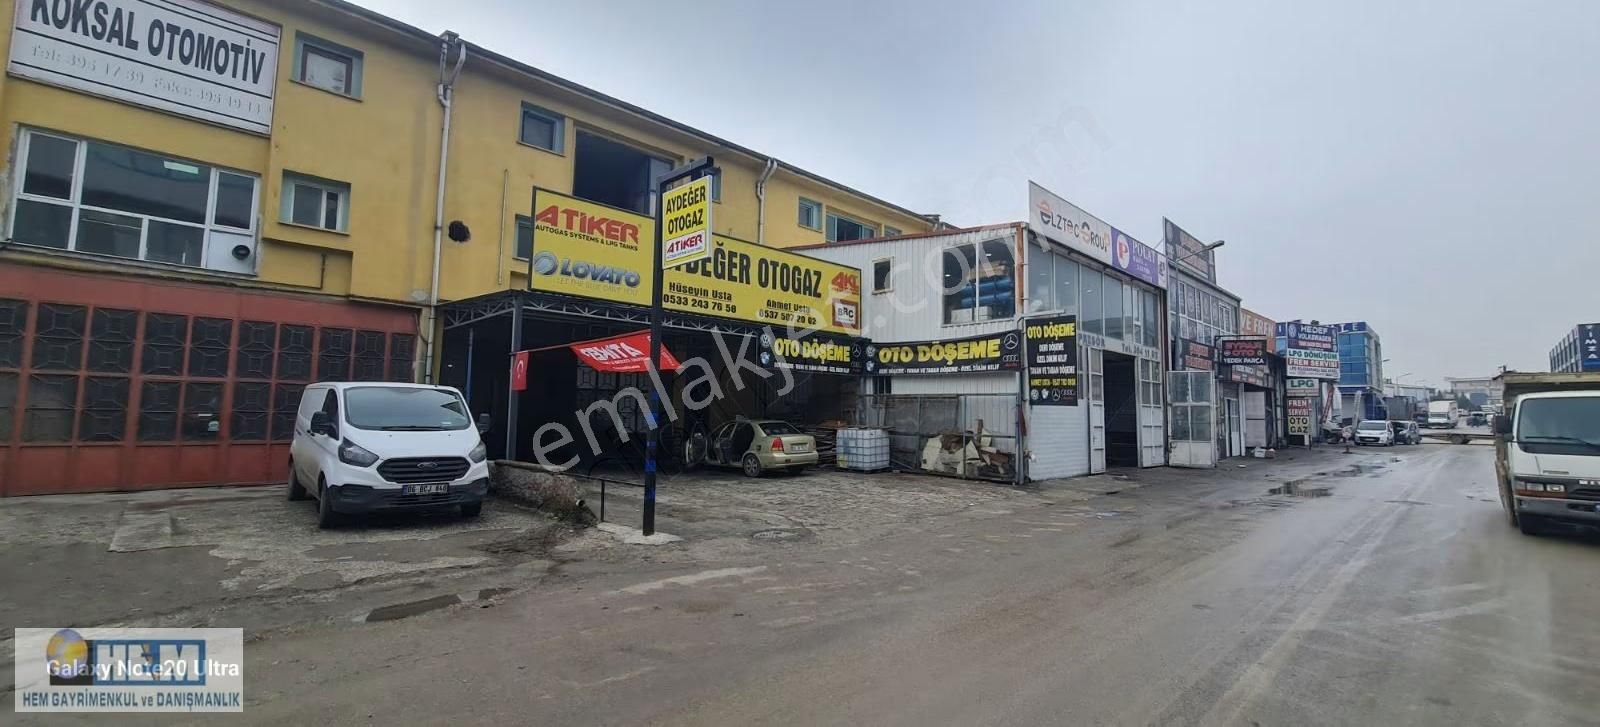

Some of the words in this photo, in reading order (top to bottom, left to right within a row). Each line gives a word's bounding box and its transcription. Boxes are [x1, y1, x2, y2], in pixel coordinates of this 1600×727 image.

[148, 19, 265, 84] OTOMOTİV
[666, 186, 706, 215] AYDEĞER
[668, 209, 704, 235] OTOGAZ
[536, 224, 568, 237] AUTOGAS
[570, 232, 599, 244] SYSTEMS
[619, 243, 638, 251] TANKS
[561, 258, 640, 288] LOVATO
[675, 241, 751, 285] EĞER
[758, 258, 822, 299] OTOGAZ
[663, 293, 689, 306] 0533
[692, 299, 709, 309] 243
[669, 282, 709, 298] Hüseyin
[712, 289, 732, 301] Usta
[766, 299, 792, 311] Ahmet
[1027, 325, 1042, 339] OTO
[1043, 321, 1075, 341] DÖŞEME
[1300, 325, 1328, 335] HEDEF
[774, 338, 800, 358] OTO
[803, 338, 851, 365] DÖŞEME
[879, 346, 914, 364] OTO
[918, 339, 1000, 366] DÖŞEME
[1289, 350, 1303, 358] LPG
[1289, 357, 1309, 366] FREN
[1291, 380, 1315, 388] LPG
[1289, 399, 1307, 407] FREN
